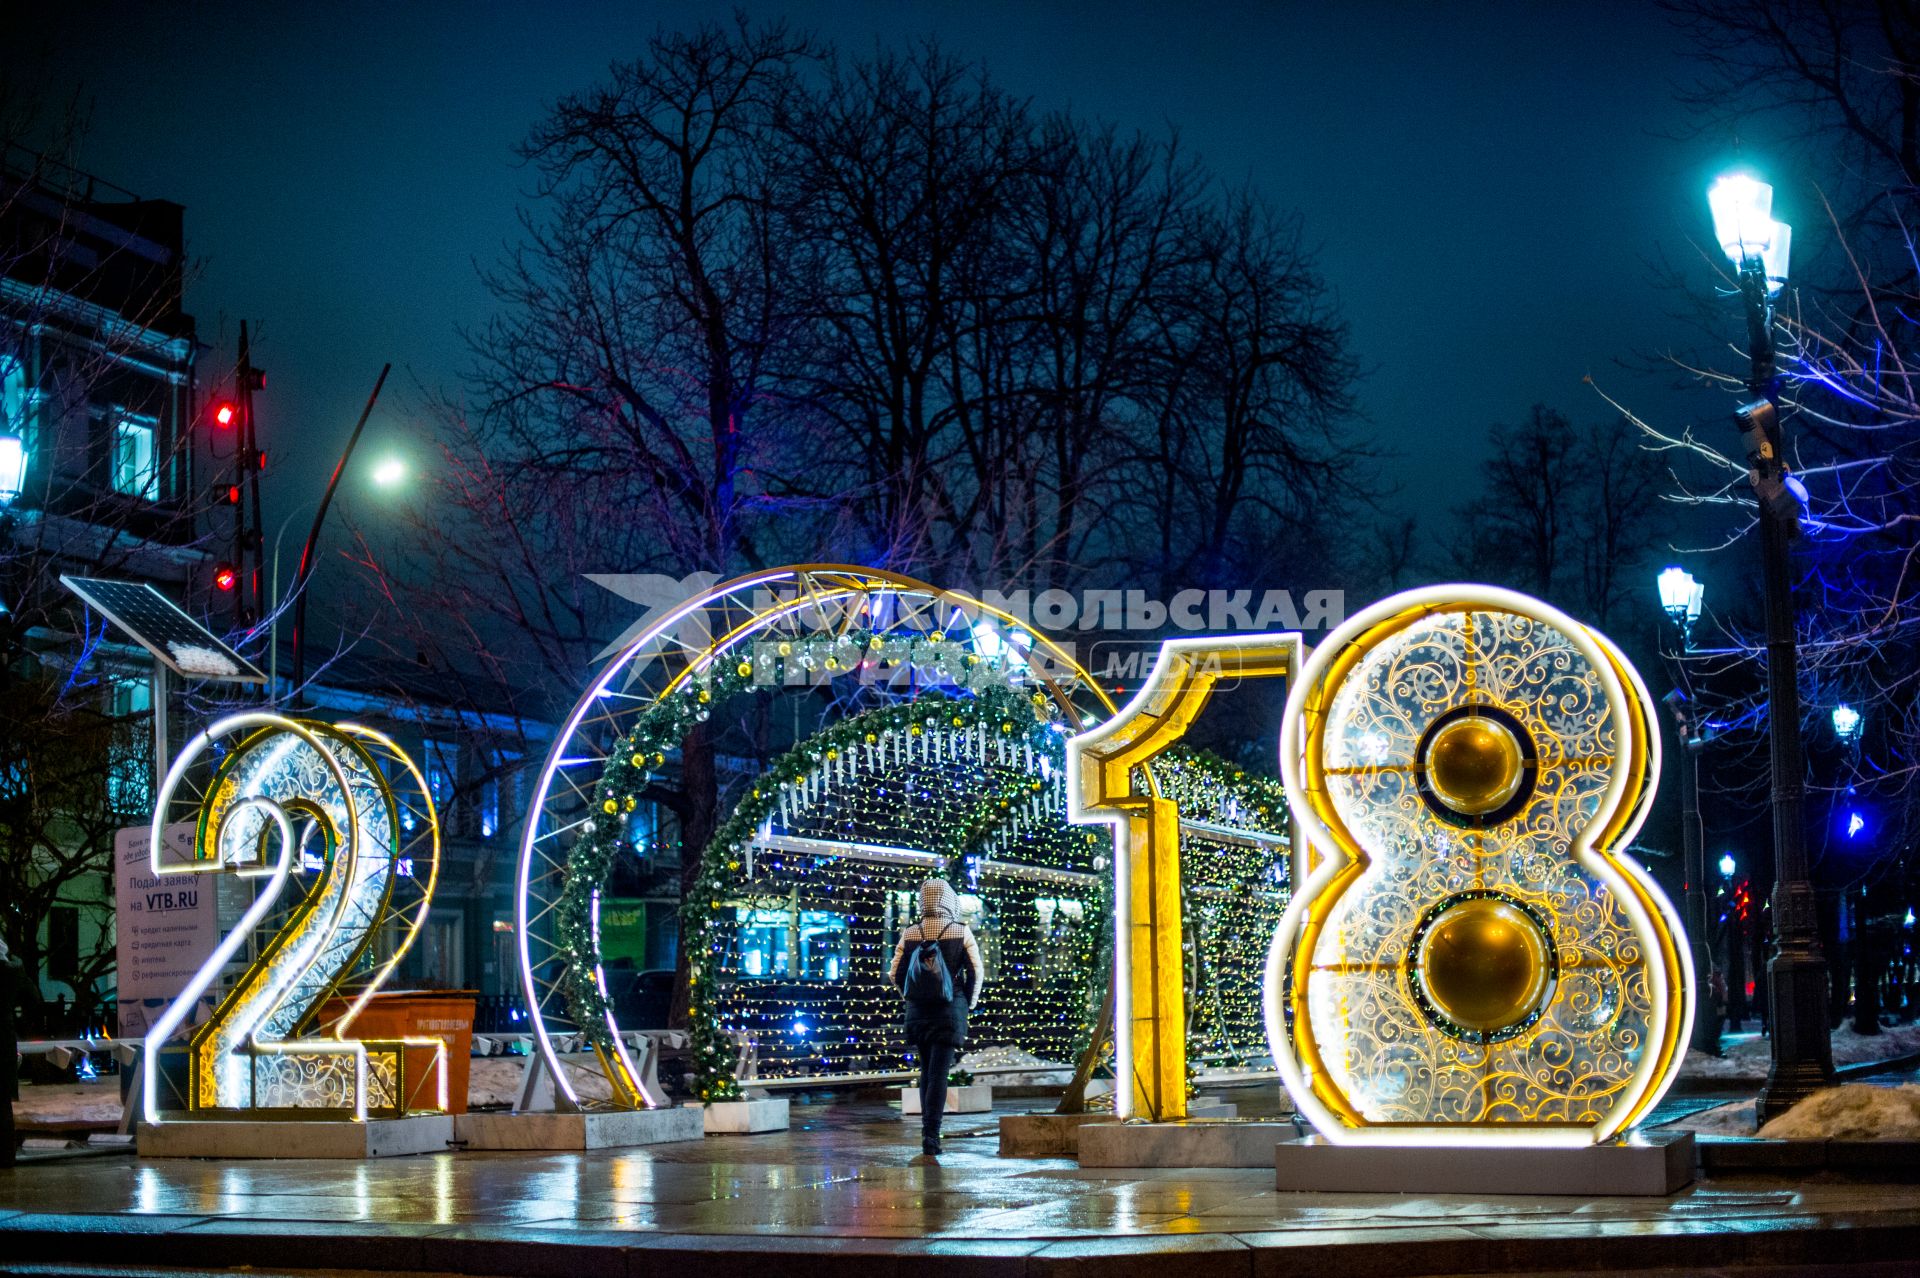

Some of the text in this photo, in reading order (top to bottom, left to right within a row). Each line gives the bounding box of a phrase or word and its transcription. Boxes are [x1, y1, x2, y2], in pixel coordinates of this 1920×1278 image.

[164, 873, 200, 887] заявку
[130, 890, 198, 912] на VTB.RU
